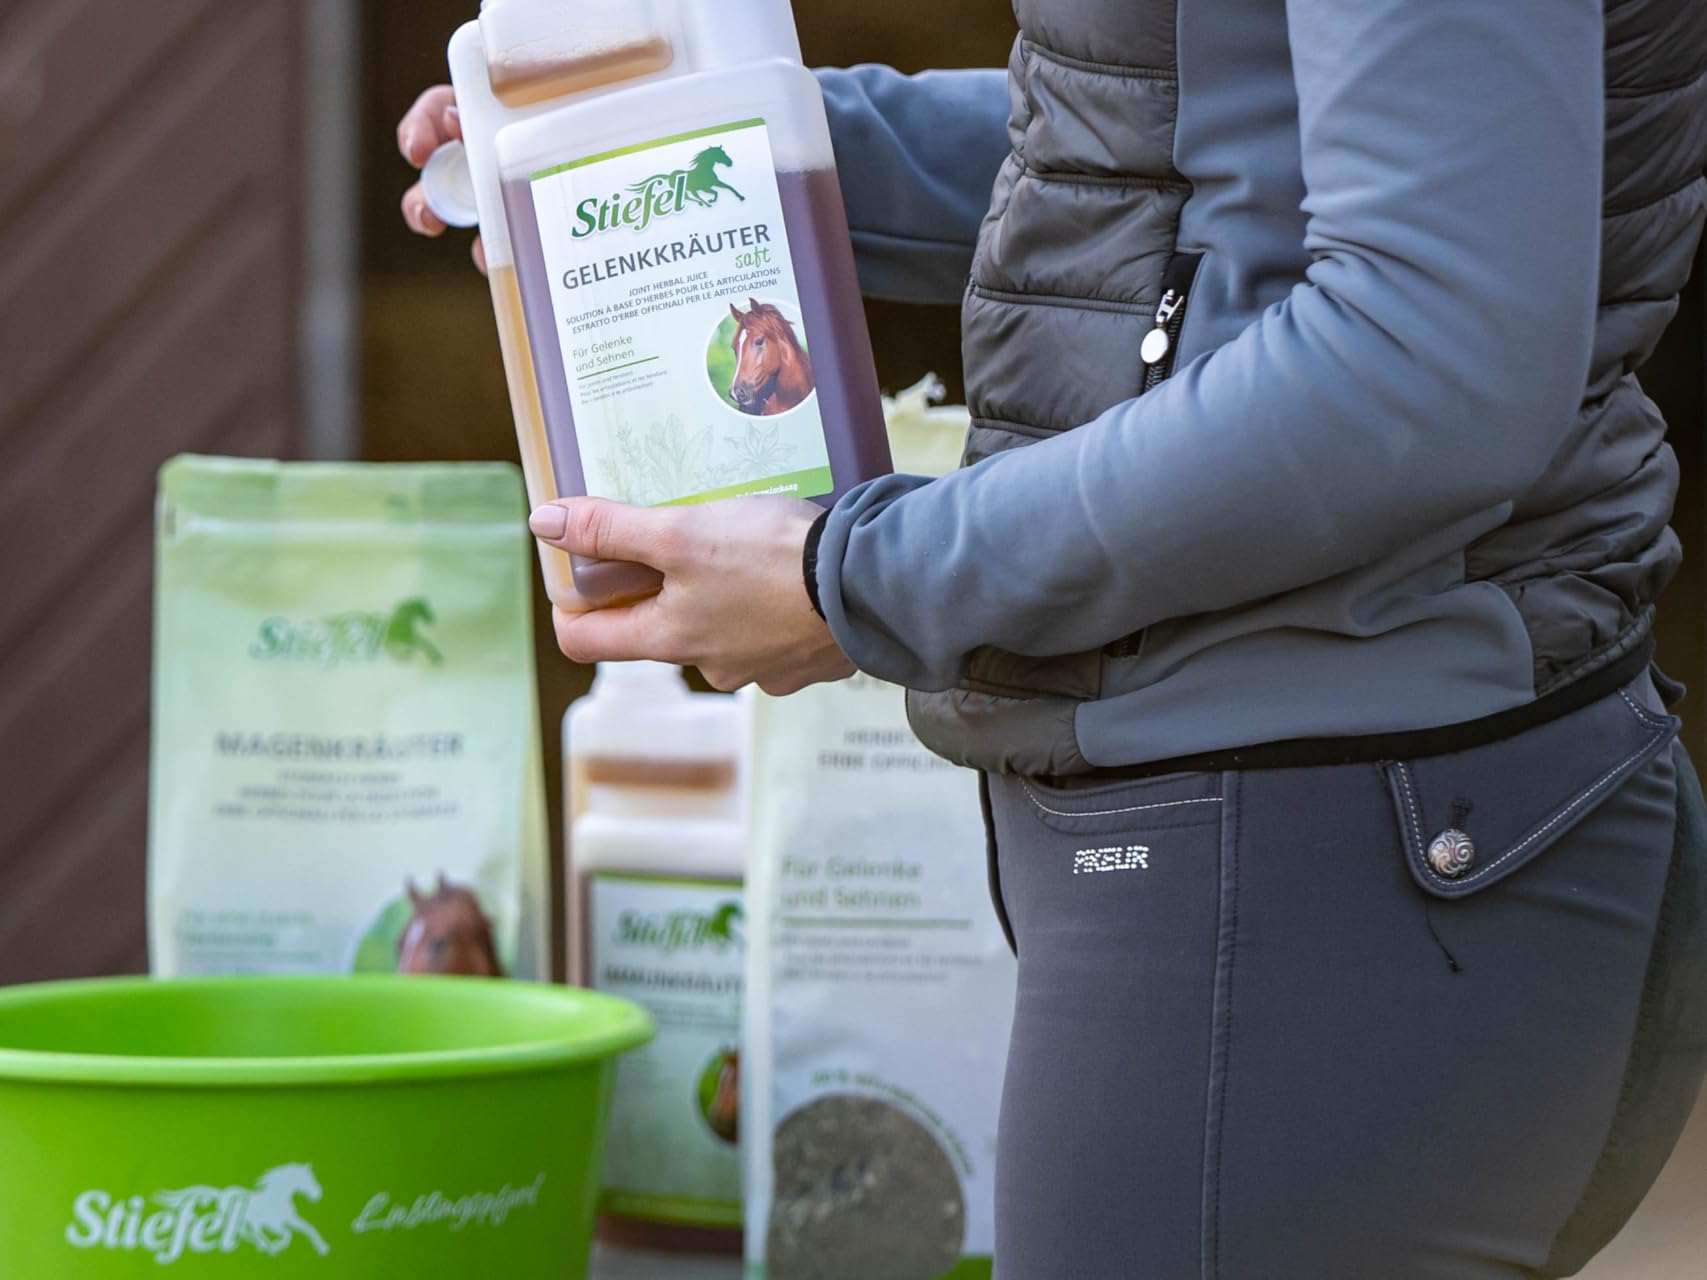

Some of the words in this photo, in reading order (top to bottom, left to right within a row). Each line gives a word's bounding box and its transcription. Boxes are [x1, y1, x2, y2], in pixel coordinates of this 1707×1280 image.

[571, 175, 687, 238] Stiefel
[562, 223, 771, 290] GELENKKRÄUTER
[629, 285, 651, 297] JOINT
[653, 277, 685, 291] HERBAL
[685, 271, 708, 283] JUICE
[735, 245, 771, 269] saft
[565, 308, 604, 326] SOLUTION
[613, 300, 633, 312] BASE
[635, 290, 674, 305] D'HERBES
[675, 283, 698, 296] POUR
[700, 280, 714, 290] LES
[716, 266, 781, 286] ARTICULATIONS
[572, 317, 610, 334] ESTRATTO
[611, 310, 639, 323] D'ERBE
[640, 299, 684, 315] OFFICINALI
[685, 294, 701, 304] PER
[702, 291, 712, 300] LE
[714, 278, 778, 298] ARTICOLAZIONI
[572, 347, 589, 359] Für
[591, 335, 633, 354] Gelenke
[575, 359, 595, 372] und
[596, 349, 635, 366] Sehnen
[65, 1188, 250, 1265] Stiefel
